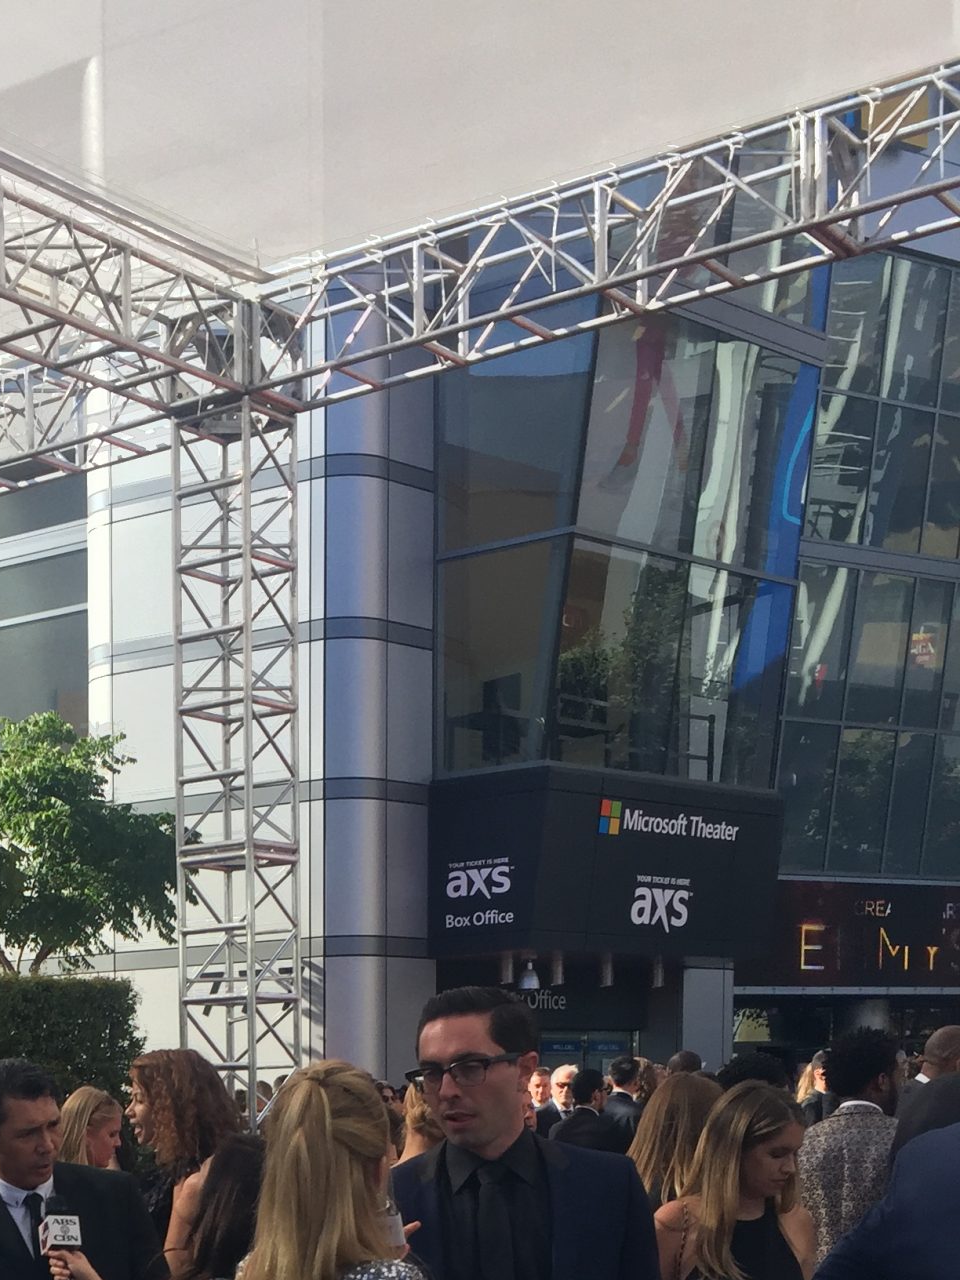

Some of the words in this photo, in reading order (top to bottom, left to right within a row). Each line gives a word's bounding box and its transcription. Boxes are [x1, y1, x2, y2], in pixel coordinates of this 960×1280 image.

[623, 808, 688, 836] Microsoft
[690, 816, 739, 841] Theater
[637, 875, 652, 883] YOUR
[652, 876, 670, 884] TICKET
[676, 878, 690, 886] HERE
[445, 914, 471, 929] Box
[473, 909, 514, 926] Office
[527, 988, 567, 1011] Office
